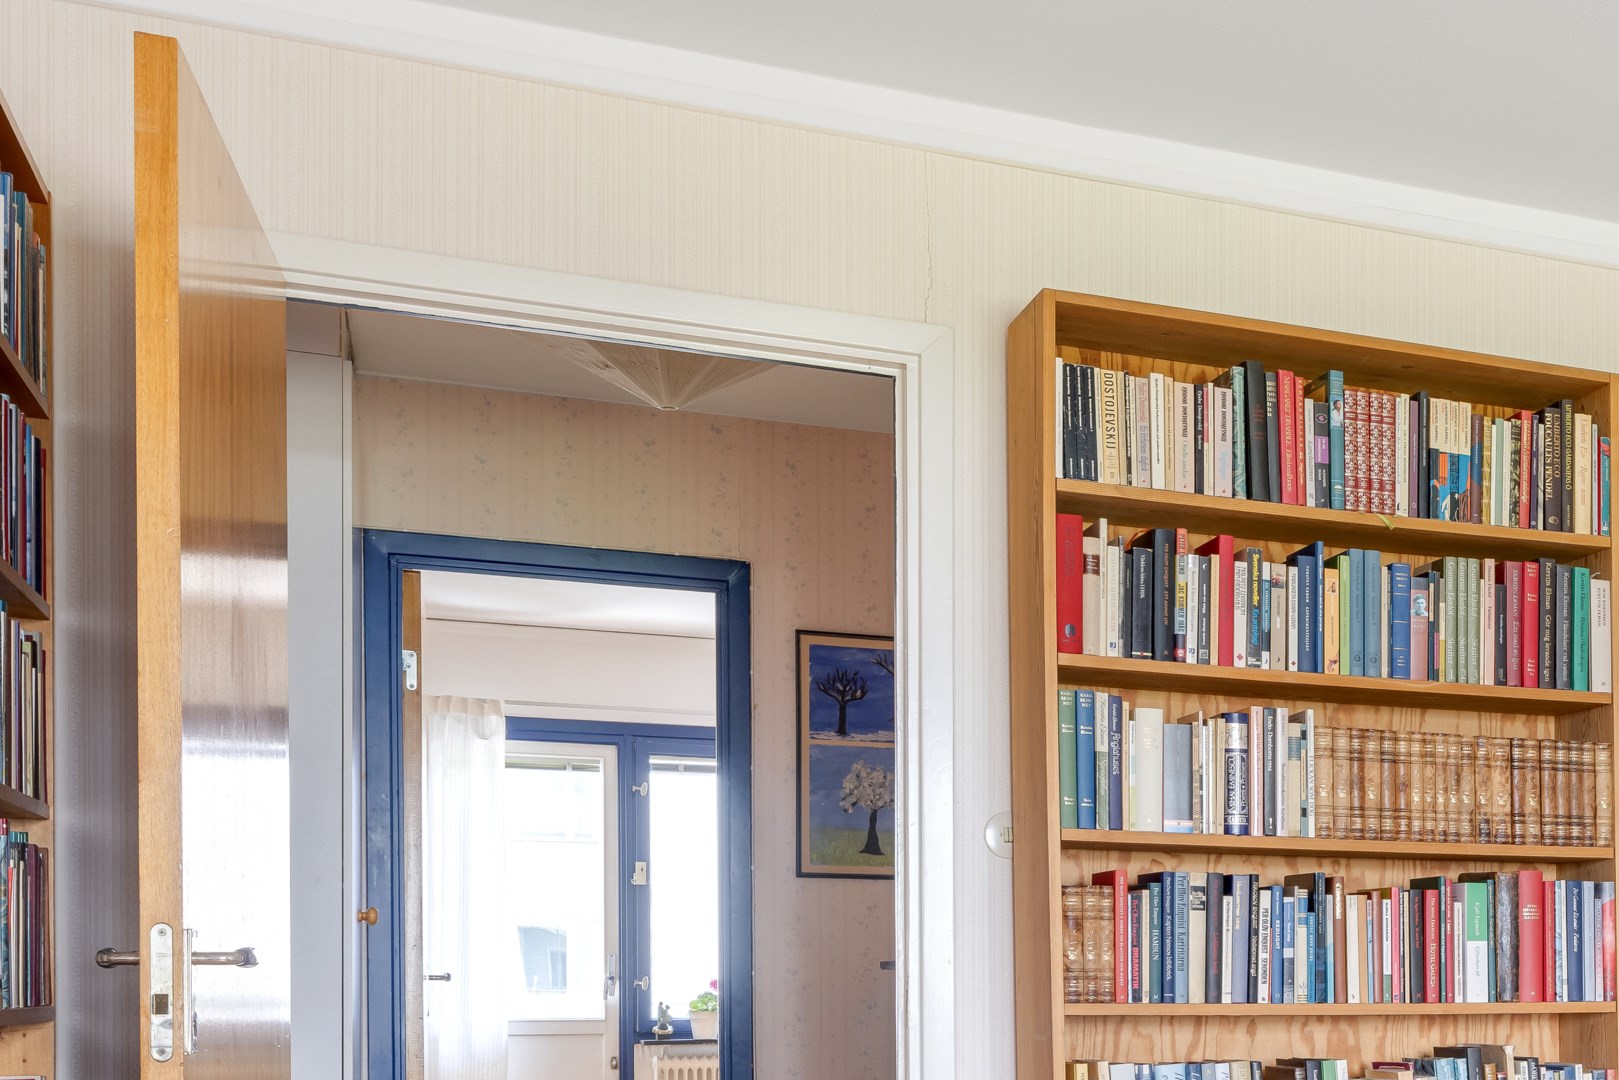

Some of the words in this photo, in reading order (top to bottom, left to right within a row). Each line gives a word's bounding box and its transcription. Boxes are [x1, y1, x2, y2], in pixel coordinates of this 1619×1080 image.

[1104, 373, 1116, 449] DOSTOJEVSKIJ
[1545, 413, 1553, 463] FOUCAULTS
[1553, 414, 1561, 457] UMBERTO
[1553, 459, 1561, 478] ECO
[1545, 466, 1553, 500] PENDEL
[1178, 584, 1186, 594] JAG
[1178, 595, 1186, 619] KOMMER
[1252, 609, 1259, 617] En
[1251, 618, 1259, 645] antologi
[1543, 668, 1551, 682] igen
[1177, 875, 1186, 887] Per
[1177, 887, 1186, 902] Olov
[1175, 903, 1186, 929] Enquist
[1261, 908, 1269, 918] PER
[1261, 918, 1269, 931] OLOV
[1177, 932, 1186, 971] Kartritarna
[1261, 932, 1269, 953] ENQUIST
